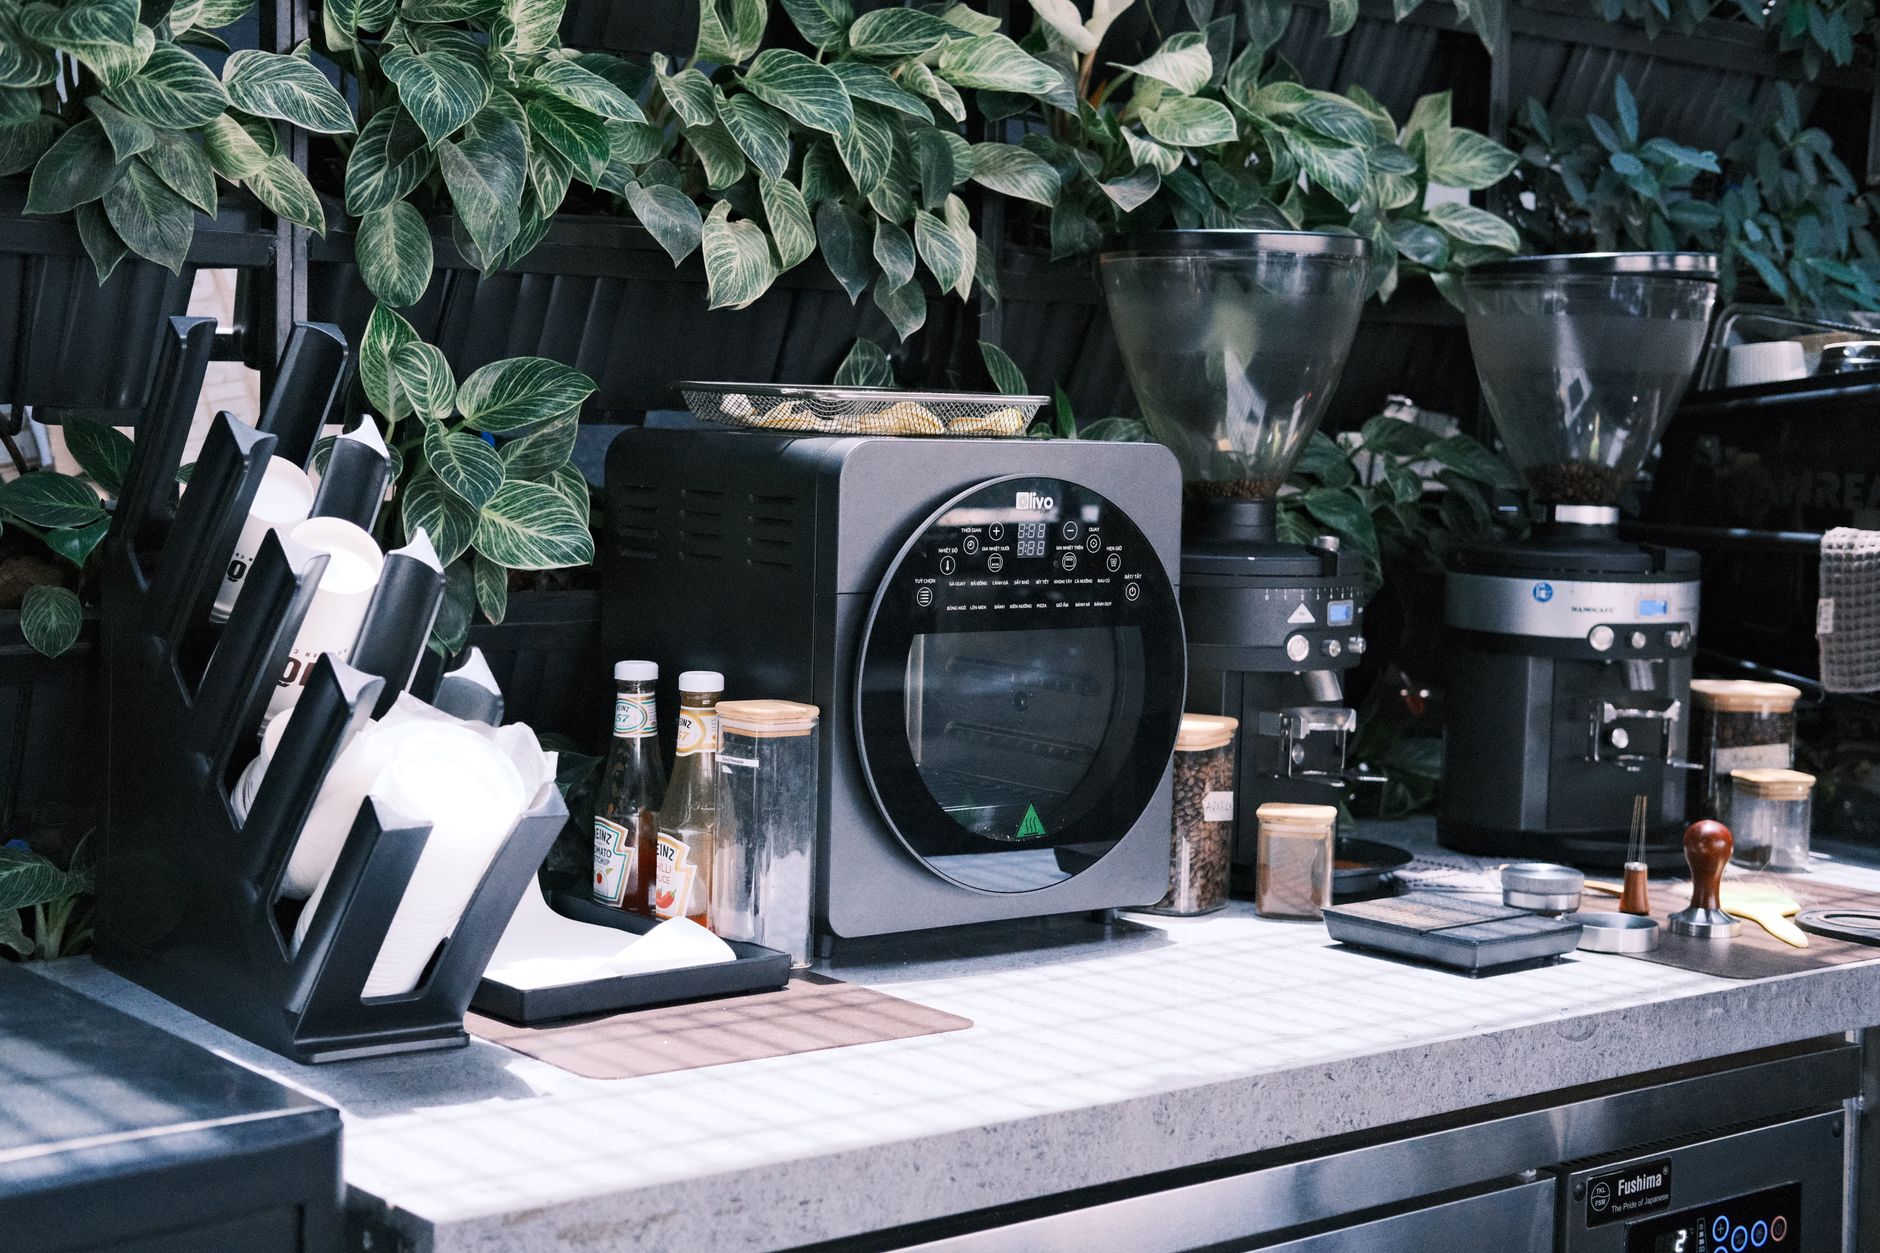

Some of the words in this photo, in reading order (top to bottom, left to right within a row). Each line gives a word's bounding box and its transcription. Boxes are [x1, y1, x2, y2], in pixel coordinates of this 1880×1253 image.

[596, 828, 612, 845] EINZ
[594, 845, 612, 858] MATO
[657, 843, 675, 861] EINZ
[657, 862, 671, 874] HILLI
[657, 874, 671, 884] UCE
[1618, 1173, 1662, 1196] Fushima
[1623, 1202, 1637, 1210] Pride
[1644, 1194, 1669, 1205] Japanese
